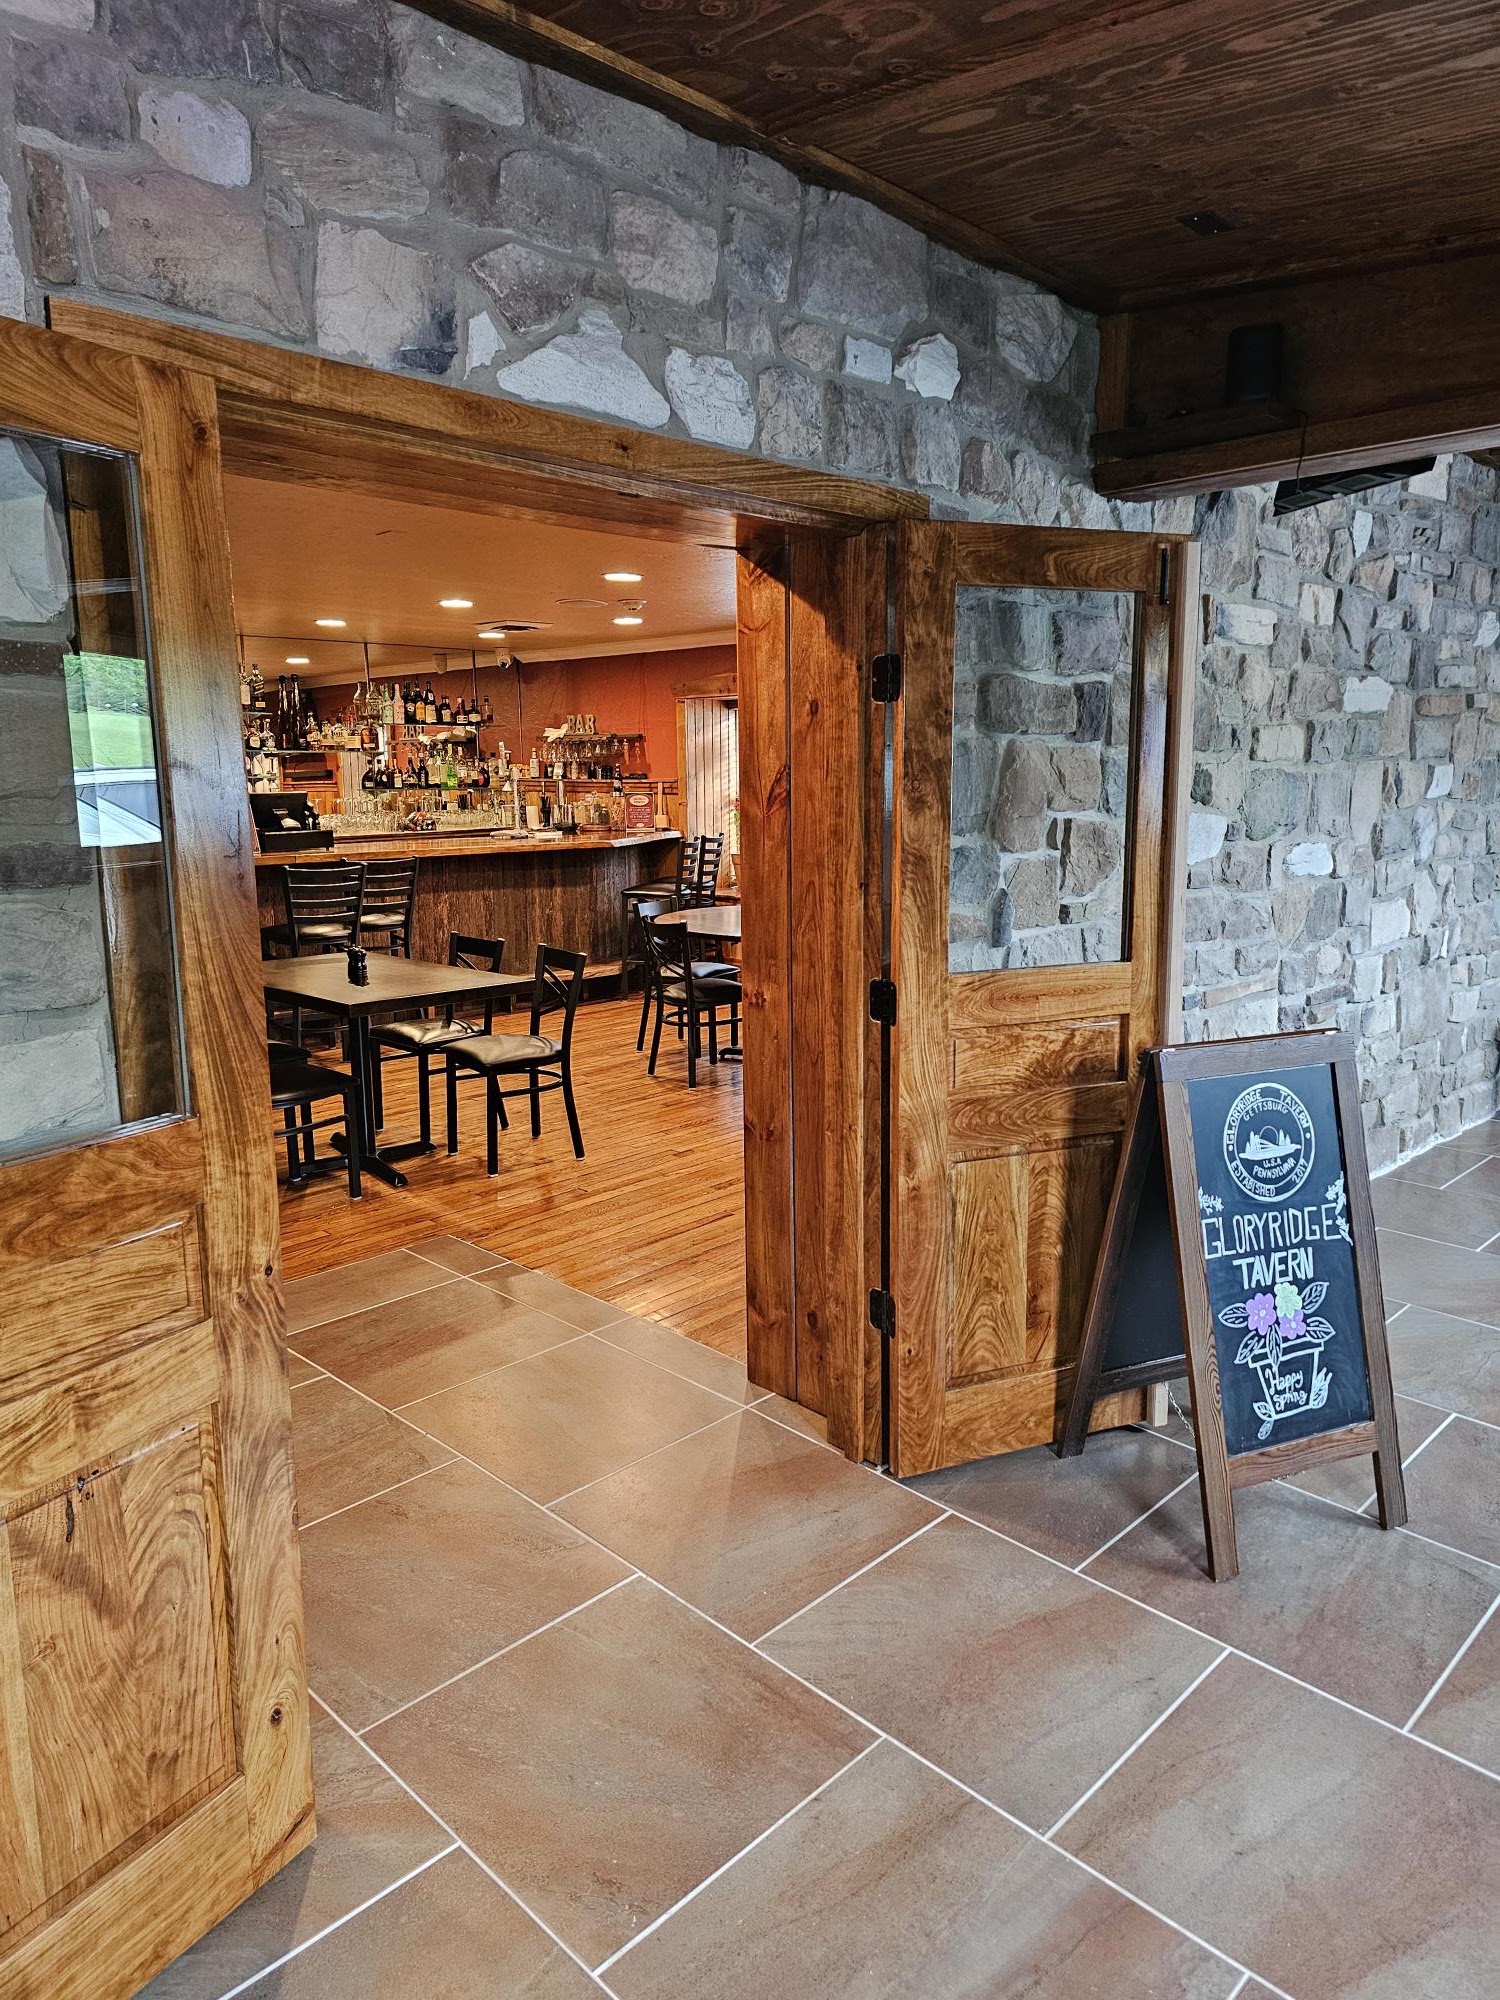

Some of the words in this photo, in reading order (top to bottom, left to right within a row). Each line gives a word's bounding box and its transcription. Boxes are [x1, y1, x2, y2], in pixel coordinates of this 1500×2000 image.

[567, 714, 595, 734] BAR
[1227, 1089, 1262, 1145] GLORYRIDGE
[1280, 1090, 1310, 1128] TAVERN
[1291, 1158, 1309, 1184] 2017
[1201, 1203, 1342, 1260] GLORYRIDGE
[1232, 1247, 1314, 1290] TAVERN
[1265, 1368, 1304, 1395] Happy
